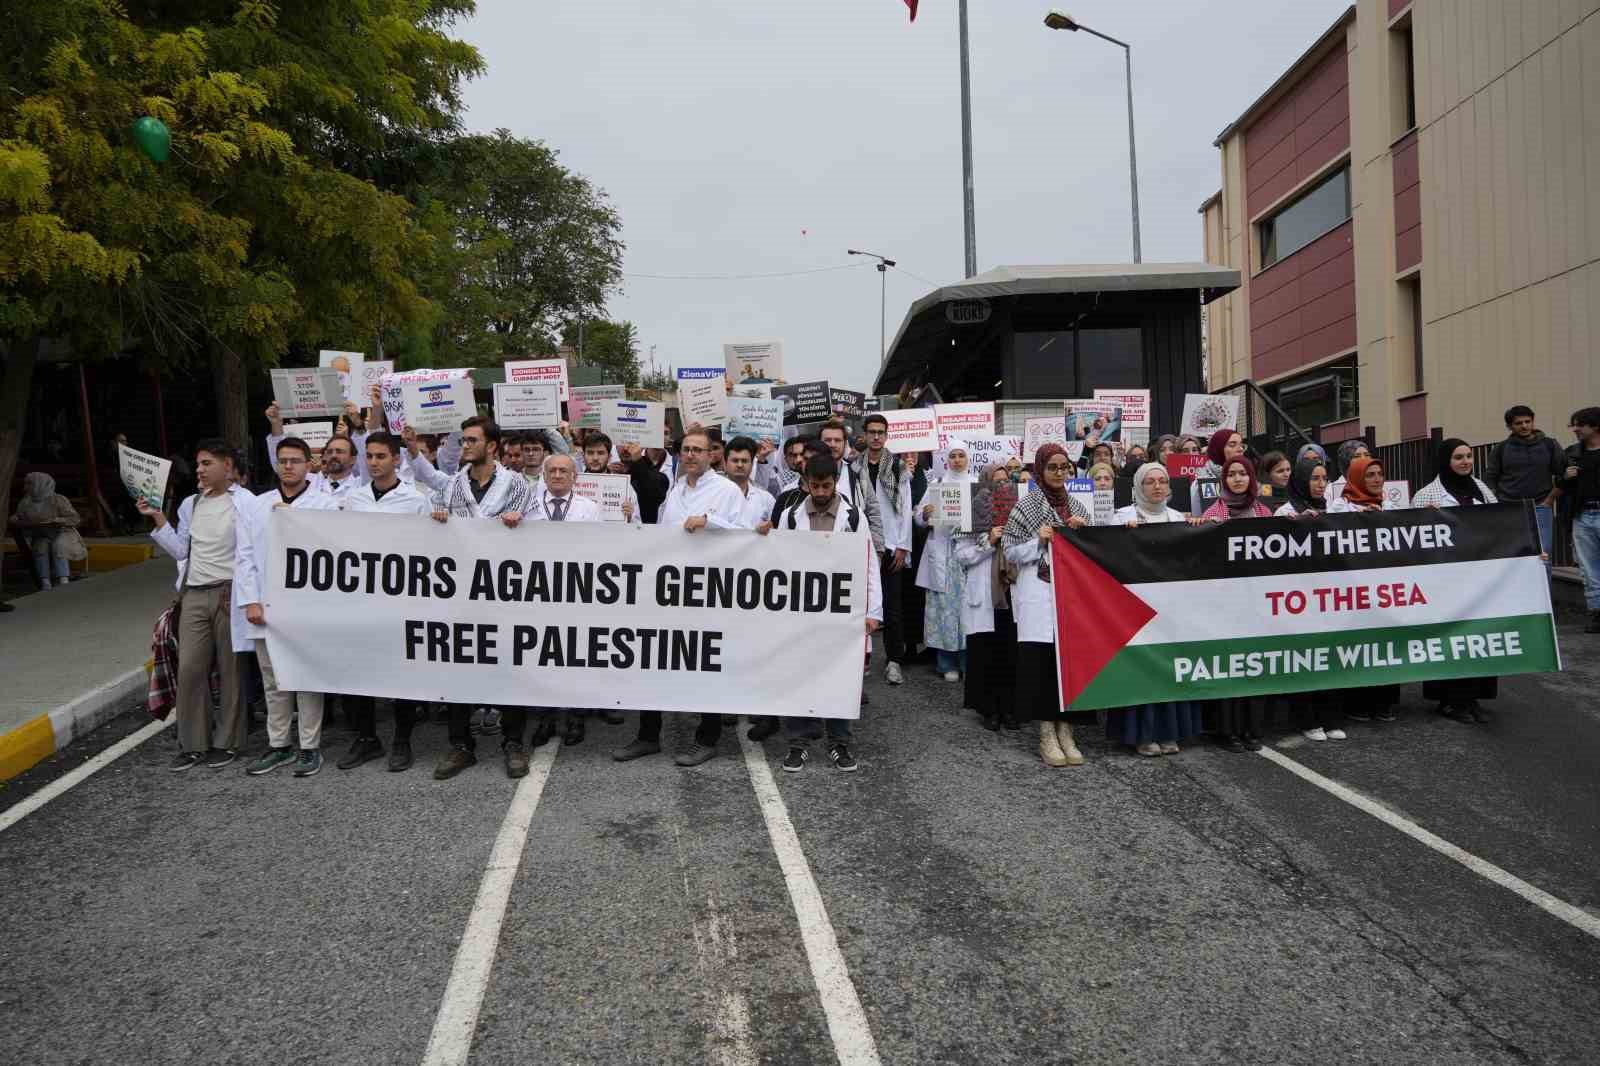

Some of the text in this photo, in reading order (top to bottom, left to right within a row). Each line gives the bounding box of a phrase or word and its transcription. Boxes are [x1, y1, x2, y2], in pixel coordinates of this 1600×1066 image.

[681, 370, 724, 378] ZionaViru
[887, 432, 929, 440] URDURUN!
[963, 440, 1002, 451] MBING
[970, 453, 989, 463] IDS
[1064, 482, 1091, 491] Virus
[1228, 523, 1455, 561] FROM THE RIVER
[285, 547, 853, 613] DOCTORS AGAINST GENOCIDE
[1265, 583, 1428, 615] TO THE SEA
[404, 620, 723, 672] FREE PALESTINE
[1173, 631, 1523, 683] PALESTINE WILL BE FREE
